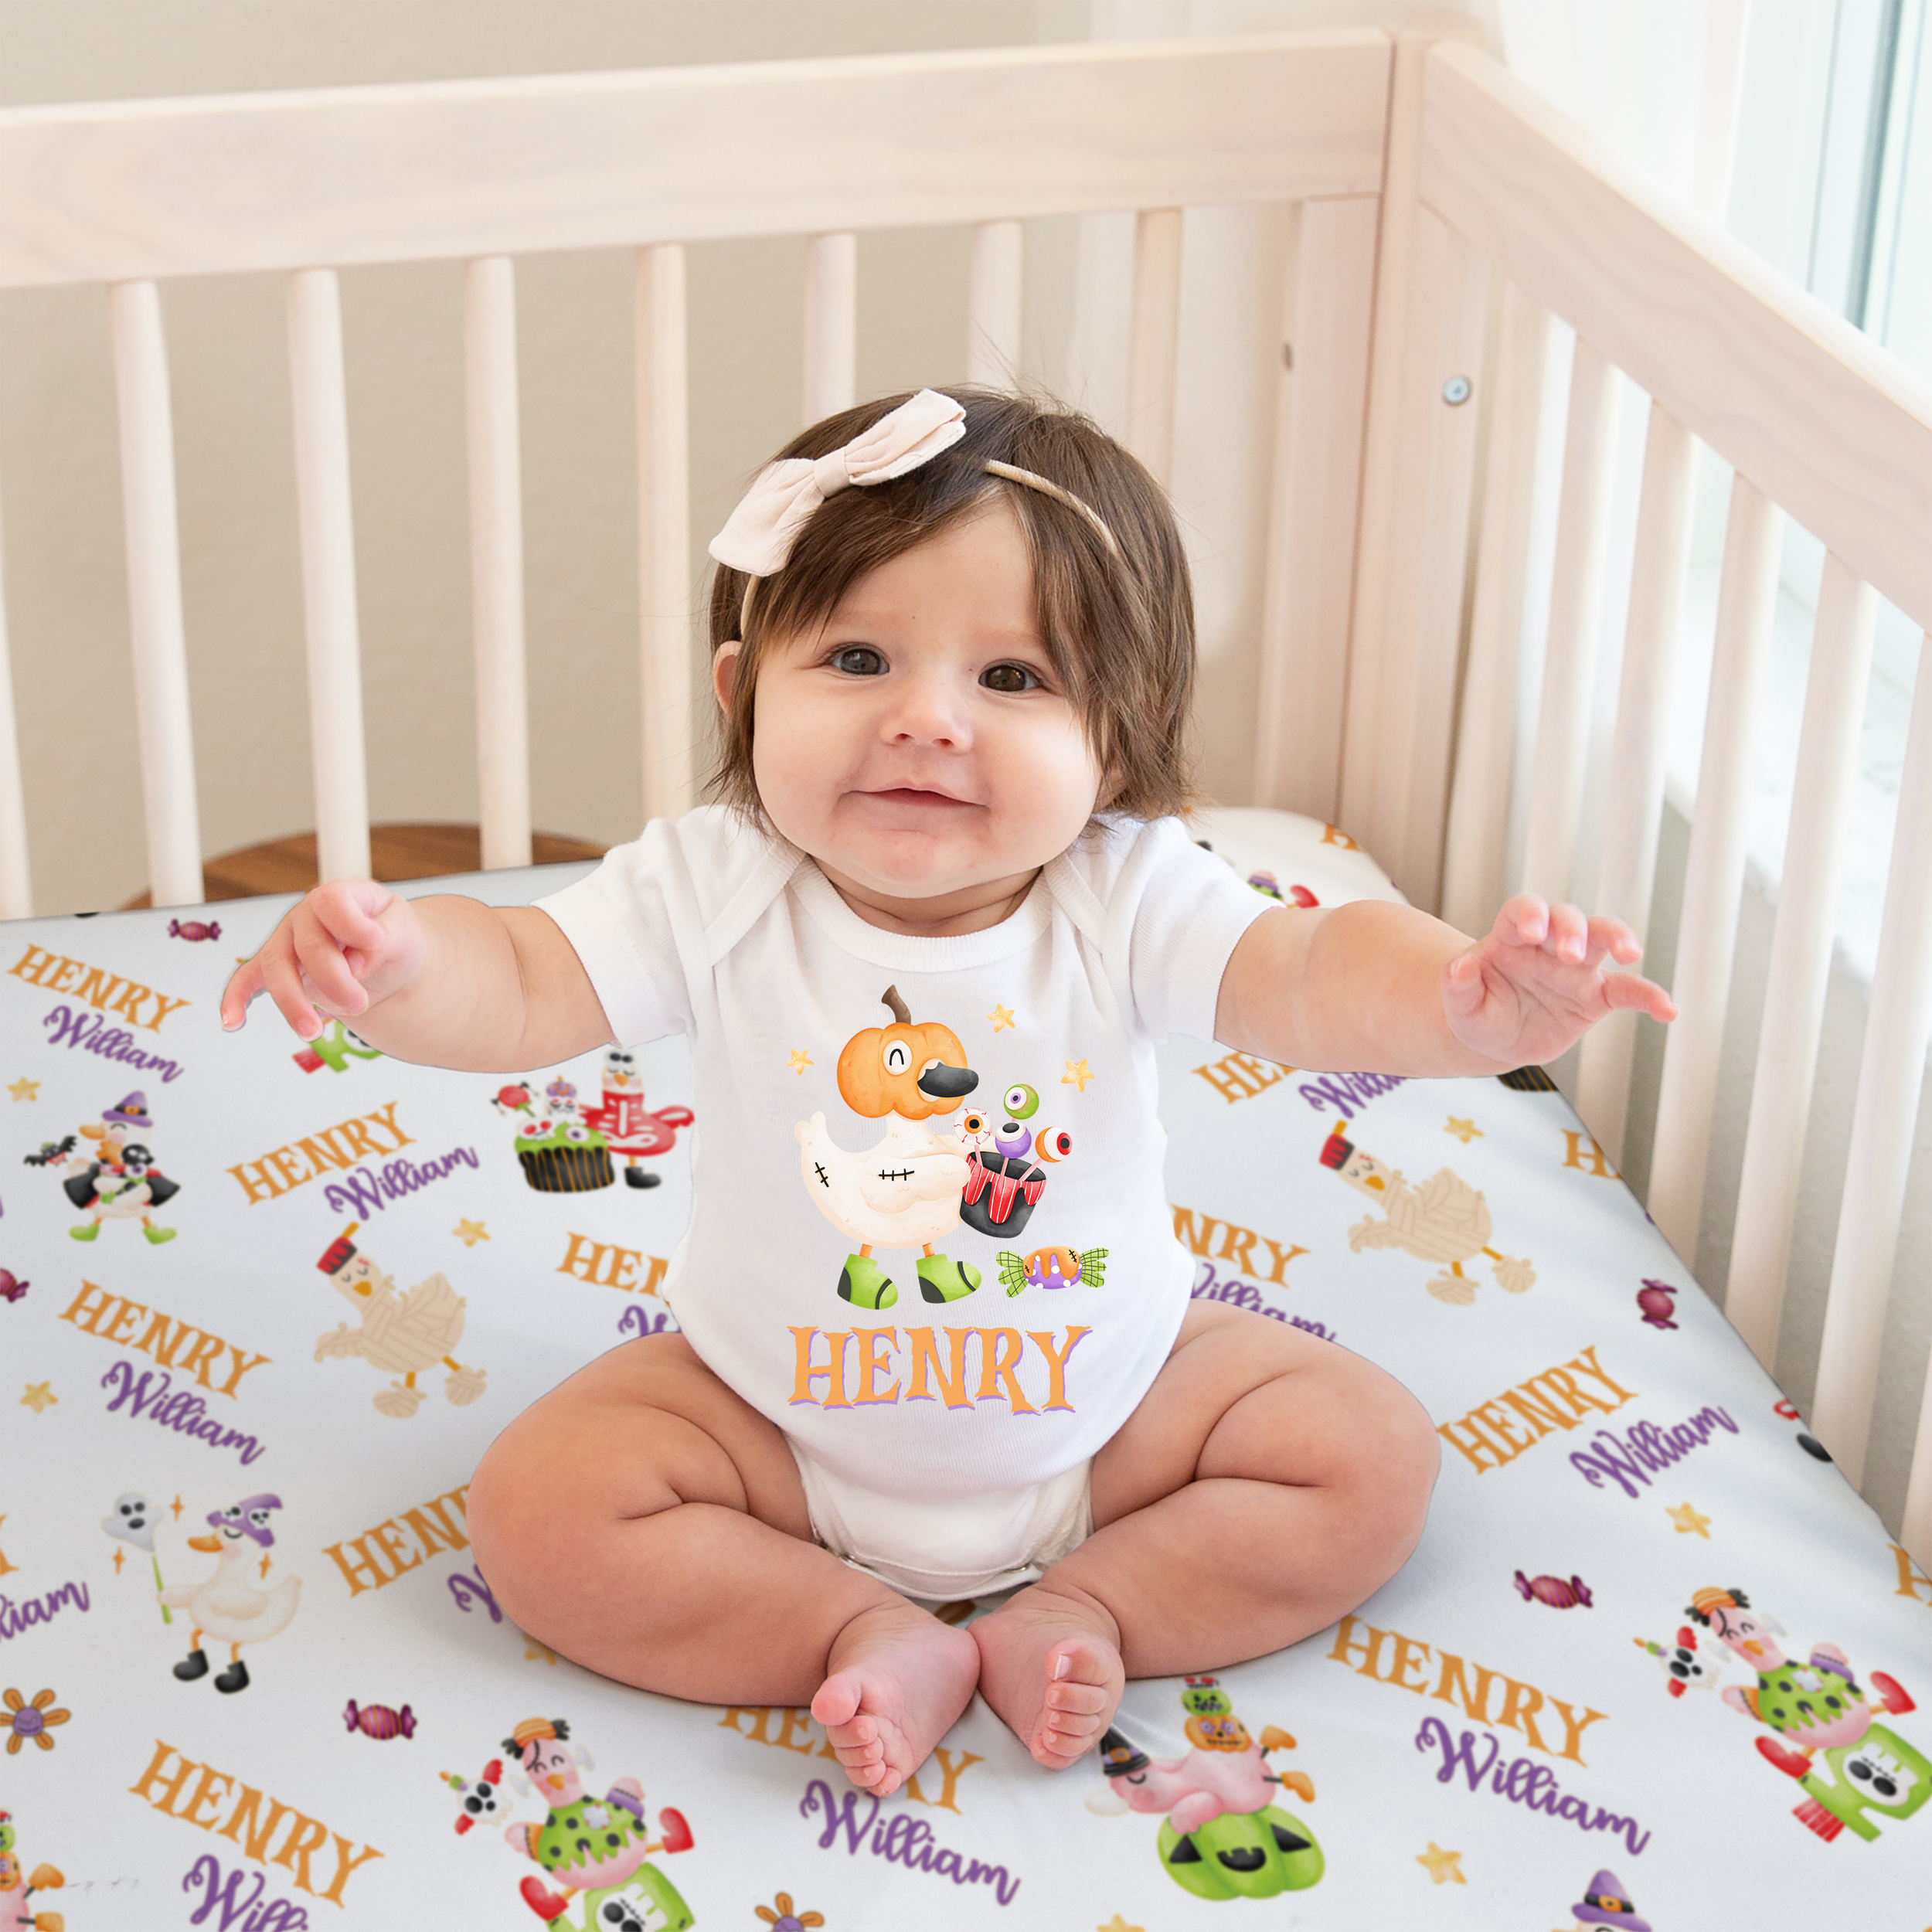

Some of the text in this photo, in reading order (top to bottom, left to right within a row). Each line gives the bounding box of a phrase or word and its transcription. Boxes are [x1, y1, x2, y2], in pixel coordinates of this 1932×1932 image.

[7, 943, 192, 1033] HENRY
[43, 1005, 184, 1083] William
[225, 1101, 416, 1206] HENRY
[324, 1146, 480, 1220] William
[58, 1279, 273, 1399] HENRY
[787, 1325, 1094, 1417] HENRY
[100, 1360, 266, 1465] William
[1437, 1345, 1639, 1475] HENRY
[1569, 1406, 1740, 1499] William
[321, 1483, 470, 1597] HEN
[1327, 1614, 1610, 1768] HENRY
[128, 1739, 386, 1910] HENRY
[1414, 1716, 1651, 1855] William
[799, 1779, 1021, 1906] William
